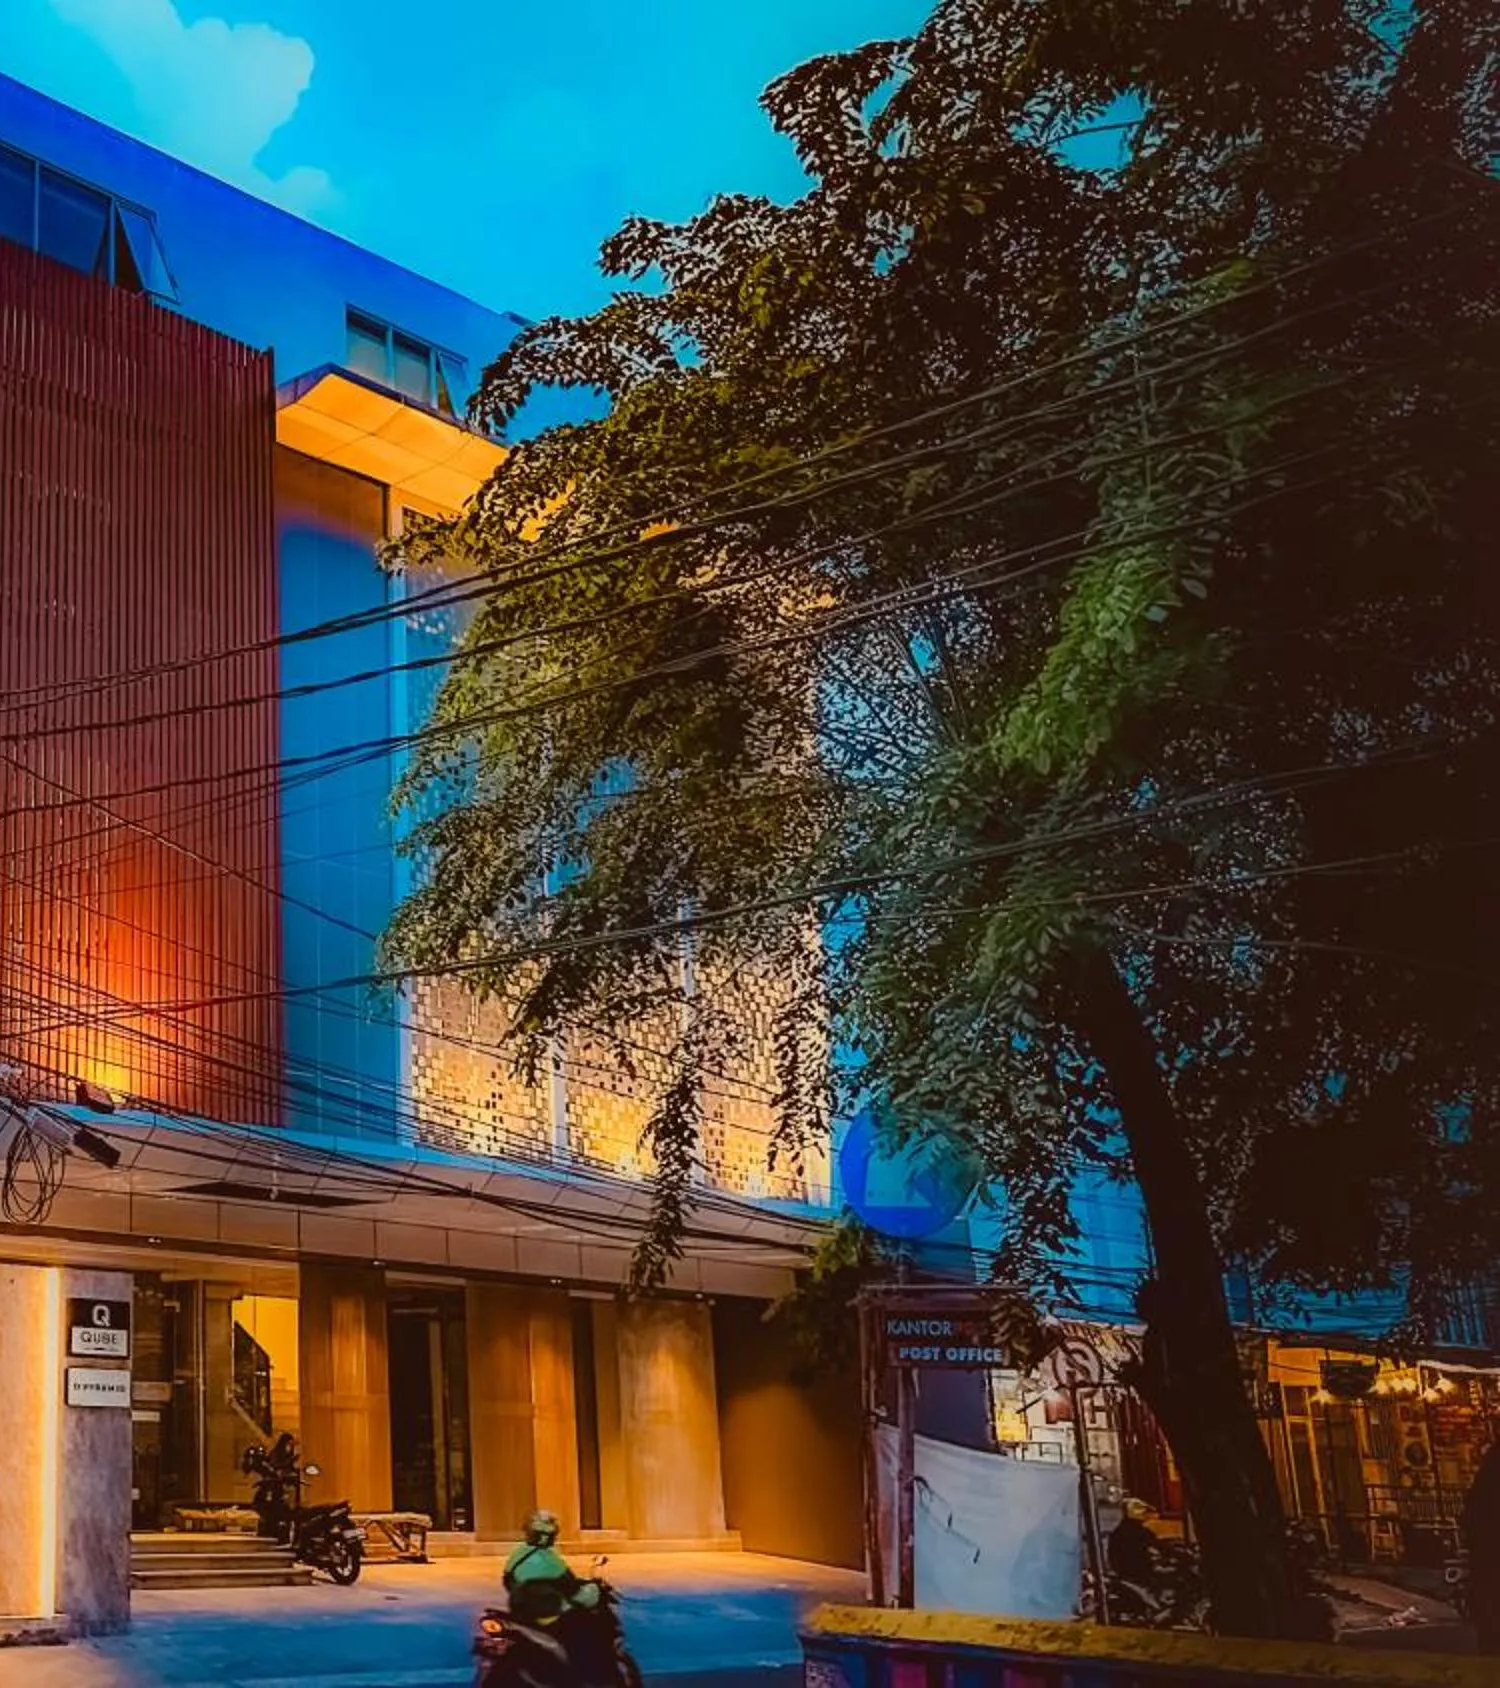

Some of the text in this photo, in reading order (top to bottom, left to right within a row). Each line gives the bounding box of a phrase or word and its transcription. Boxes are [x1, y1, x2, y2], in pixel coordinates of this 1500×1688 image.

[92, 1304, 111, 1327] Q
[886, 1320, 952, 1335] KANTOR
[80, 1331, 117, 1344] QUBE
[899, 1346, 1004, 1362] POST OFFICE
